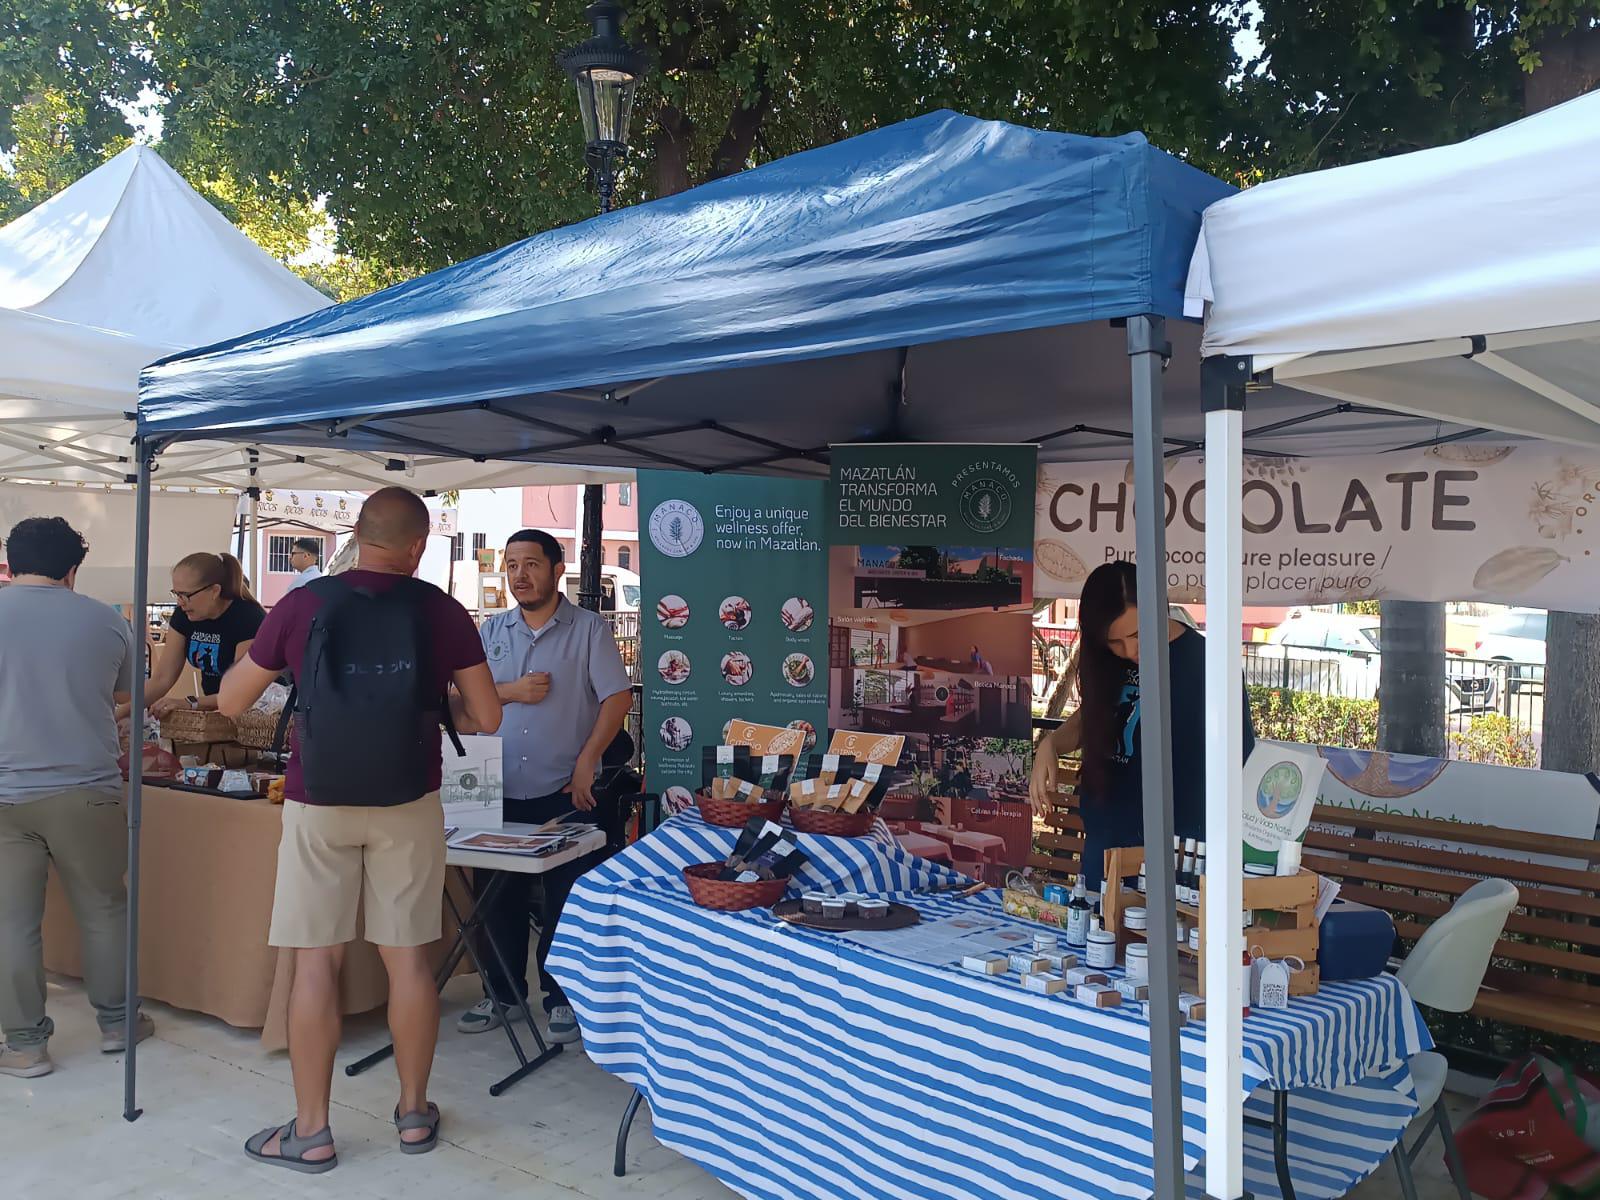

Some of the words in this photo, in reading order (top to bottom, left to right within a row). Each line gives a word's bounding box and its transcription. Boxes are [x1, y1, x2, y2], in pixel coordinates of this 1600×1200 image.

[840, 464, 916, 480] MAZATLÁN
[952, 461, 1021, 488] PRESENTAMOS
[840, 483, 938, 496] TRANSFORMA
[716, 504, 750, 522] Enjoy
[754, 510, 762, 519] a
[766, 507, 809, 522] unique
[839, 499, 856, 512] EL
[860, 499, 912, 512] MUNDO
[654, 504, 698, 524] MANACO
[839, 514, 865, 528] DEL
[869, 514, 947, 528] BIENESTAR
[716, 522, 768, 534] wellness
[772, 522, 804, 537] offer,
[716, 539, 742, 550] now
[745, 537, 756, 550] in
[760, 537, 821, 552] Mazatlan.
[1105, 546, 1137, 563] Pur
[1278, 548, 1376, 570] pleasure
[1246, 572, 1316, 593] placer
[1320, 574, 1372, 593] puro
